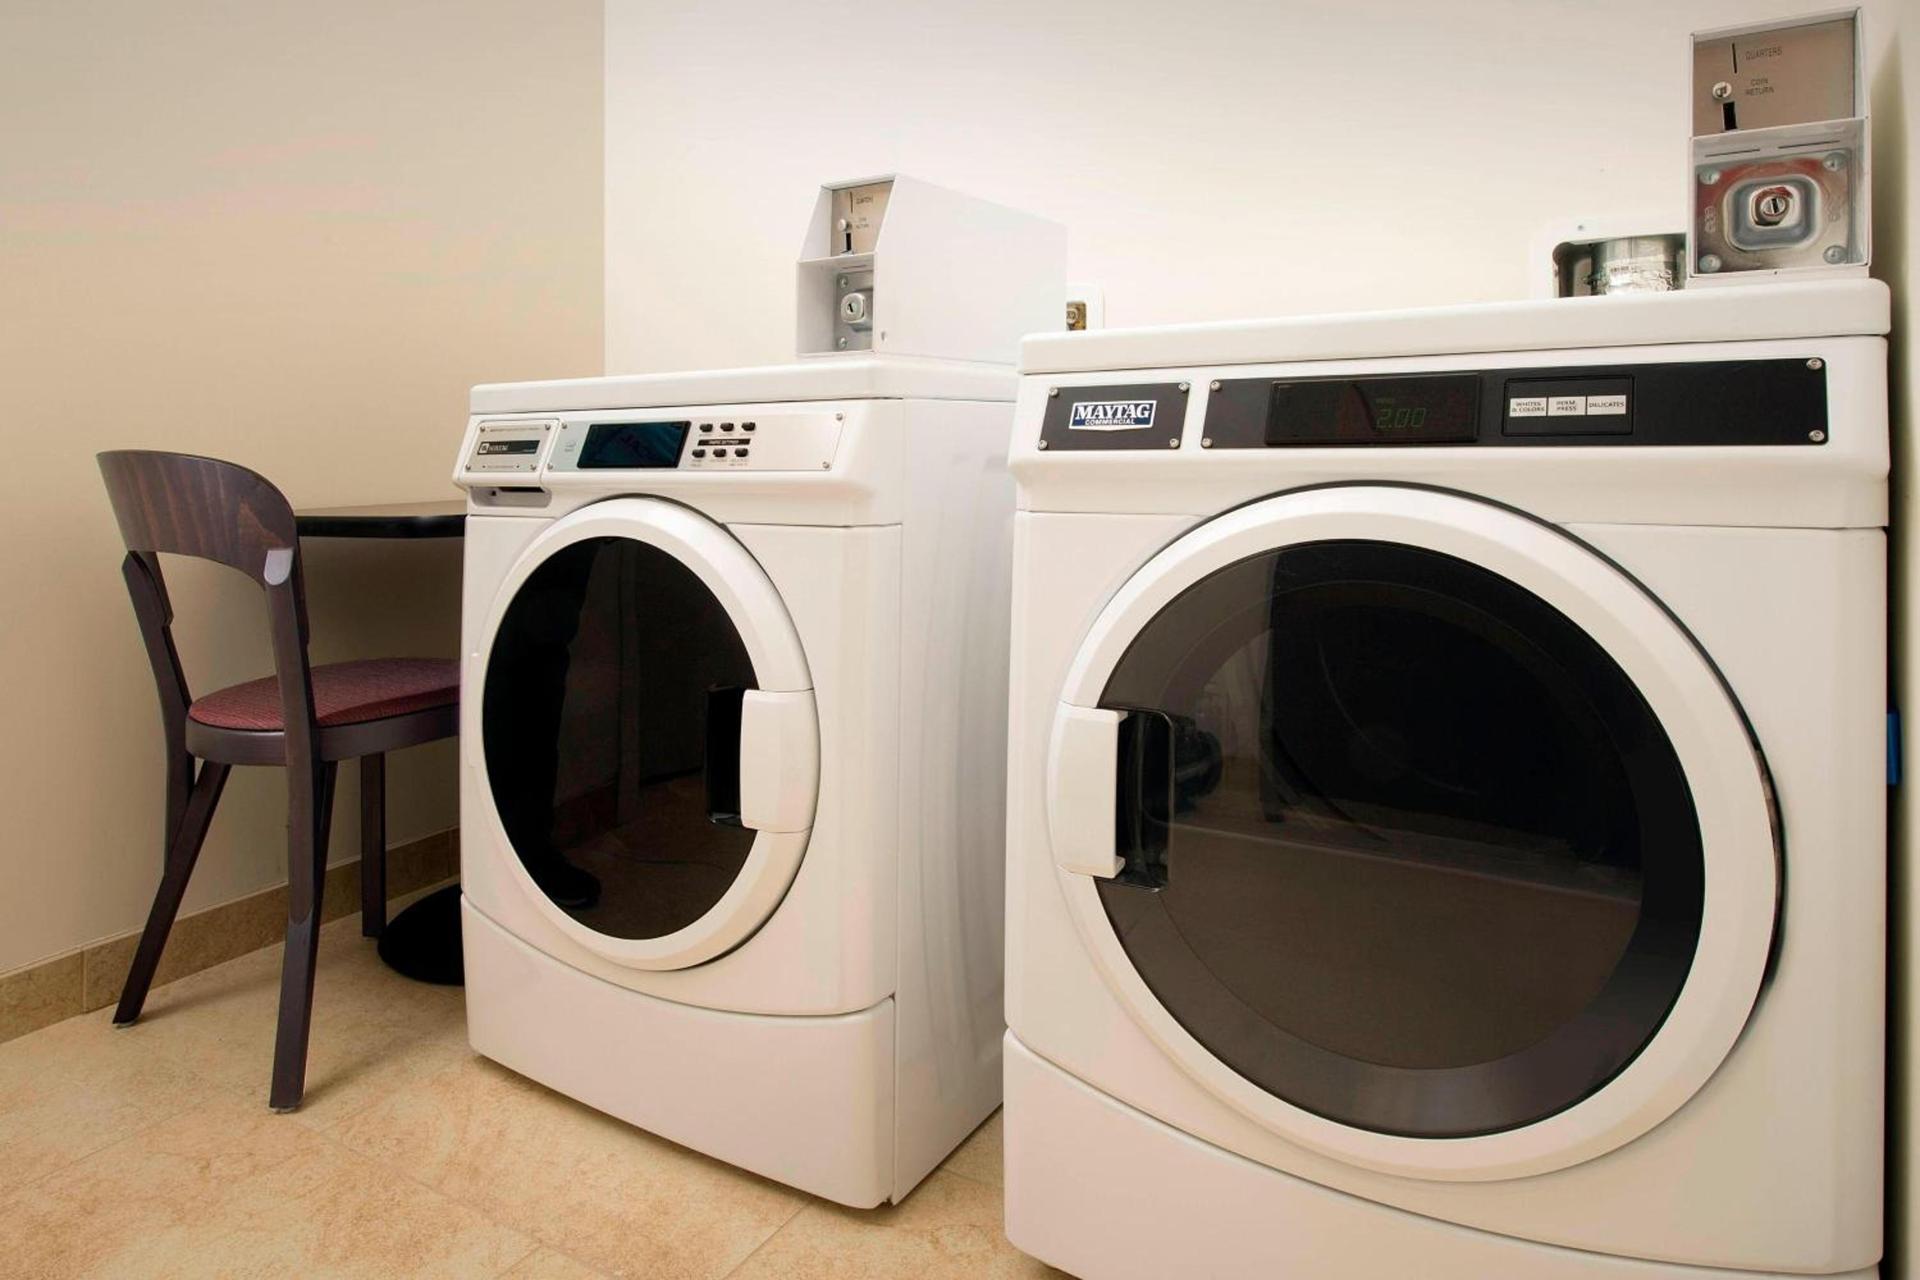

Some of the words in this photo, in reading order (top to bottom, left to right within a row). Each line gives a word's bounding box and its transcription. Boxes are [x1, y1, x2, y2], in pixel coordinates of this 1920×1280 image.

[1744, 46, 1783, 61] QUARTERS
[1745, 87, 1775, 97] RETURN
[1075, 403, 1151, 420] MAYTAG
[1085, 418, 1135, 426] COMMERCIAL
